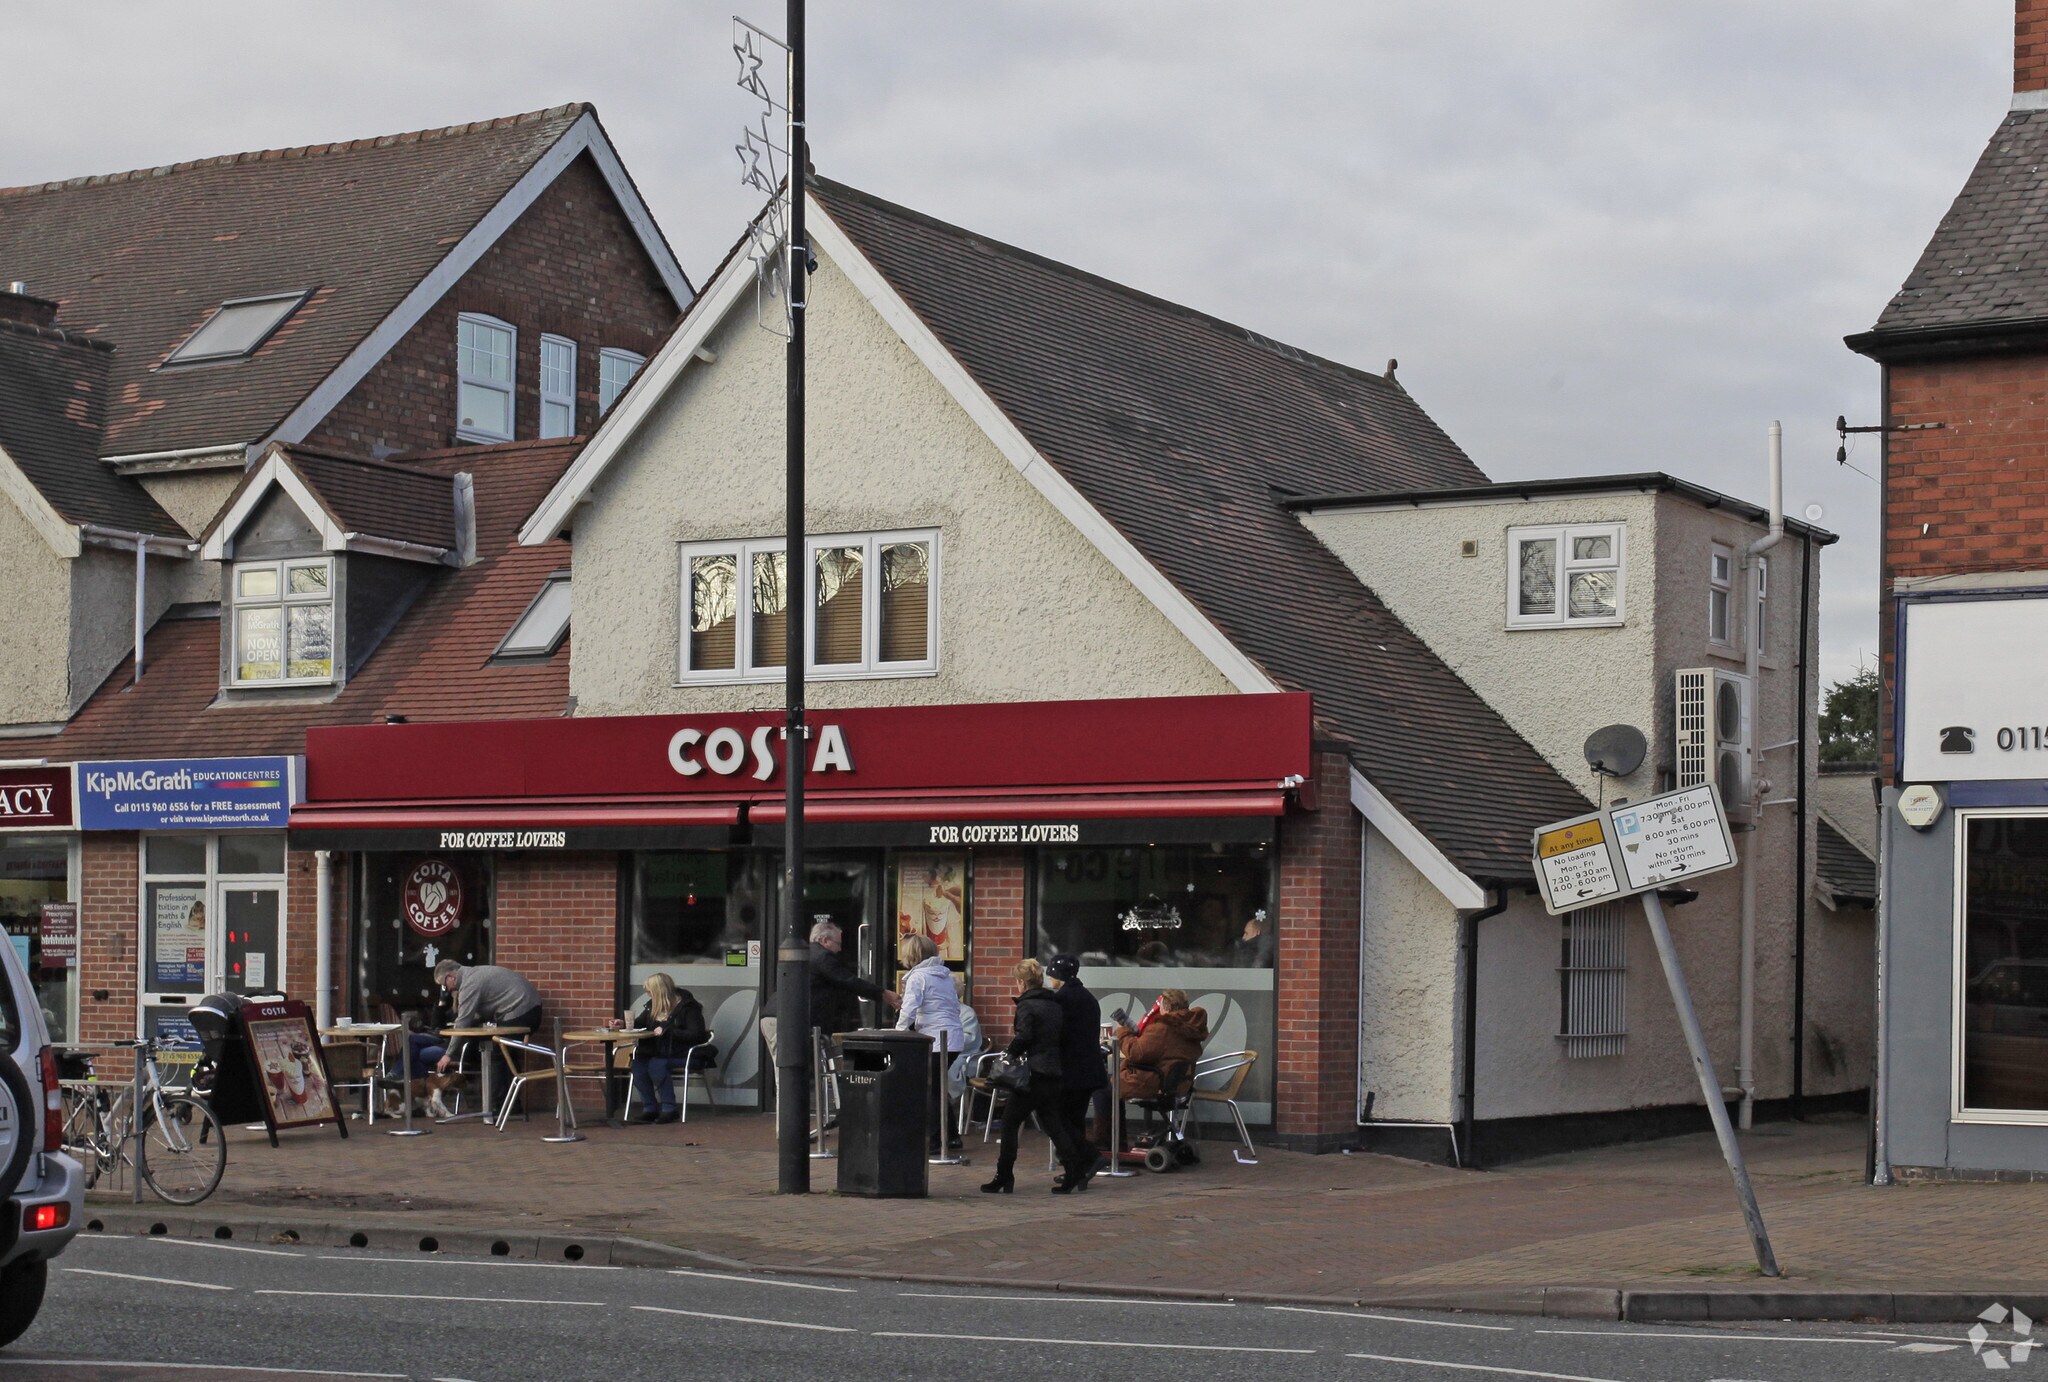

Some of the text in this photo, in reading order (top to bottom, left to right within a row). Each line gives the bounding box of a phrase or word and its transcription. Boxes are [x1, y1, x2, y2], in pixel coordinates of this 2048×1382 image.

[247, 638, 278, 650] NOW
[246, 649, 279, 662] OPEN
[115, 803, 130, 813] Call
[131, 803, 150, 812] 0115
[152, 803, 167, 812] 960
[169, 802, 189, 811] 6556
[191, 801, 202, 811] for
[211, 801, 233, 811] FREE
[234, 801, 281, 810] assessment
[1656, 801, 1673, 809] Mon
[1679, 796, 1689, 804] Fri
[1641, 813, 1659, 823] 7.30
[1697, 800, 1710, 808] pm
[170, 815, 184, 823] visit
[185, 814, 270, 824] www.kipnottsnorth.co.uk
[1671, 816, 1685, 825] Sat
[1703, 818, 1716, 826] pm
[439, 831, 566, 848] FOR COFFEE LOVERS
[929, 824, 1079, 843] FOR COFFEE LOVERS
[1667, 832, 1699, 845] 30 mins
[1561, 842, 1574, 850] any
[1576, 836, 1594, 845] time
[1554, 850, 1596, 866] No loading
[1655, 845, 1694, 859] No return
[1560, 865, 1578, 873] Mon
[1583, 860, 1594, 868] Fri
[1647, 850, 1706, 870] within 30 mins
[413, 863, 451, 884] COSTA
[1552, 876, 1570, 885] 7.30
[1575, 869, 1594, 879] 9.30
[1595, 866, 1608, 874] am
[1553, 883, 1573, 892] 4.00
[1578, 876, 1597, 886] 6.00
[1598, 874, 1611, 882] pm
[159, 893, 197, 901] Professional
[158, 912, 179, 920] maths
[409, 903, 456, 928] COFFEE
[158, 922, 182, 930] English
[261, 1006, 287, 1016] COSTA
[850, 1074, 873, 1084] Litter
